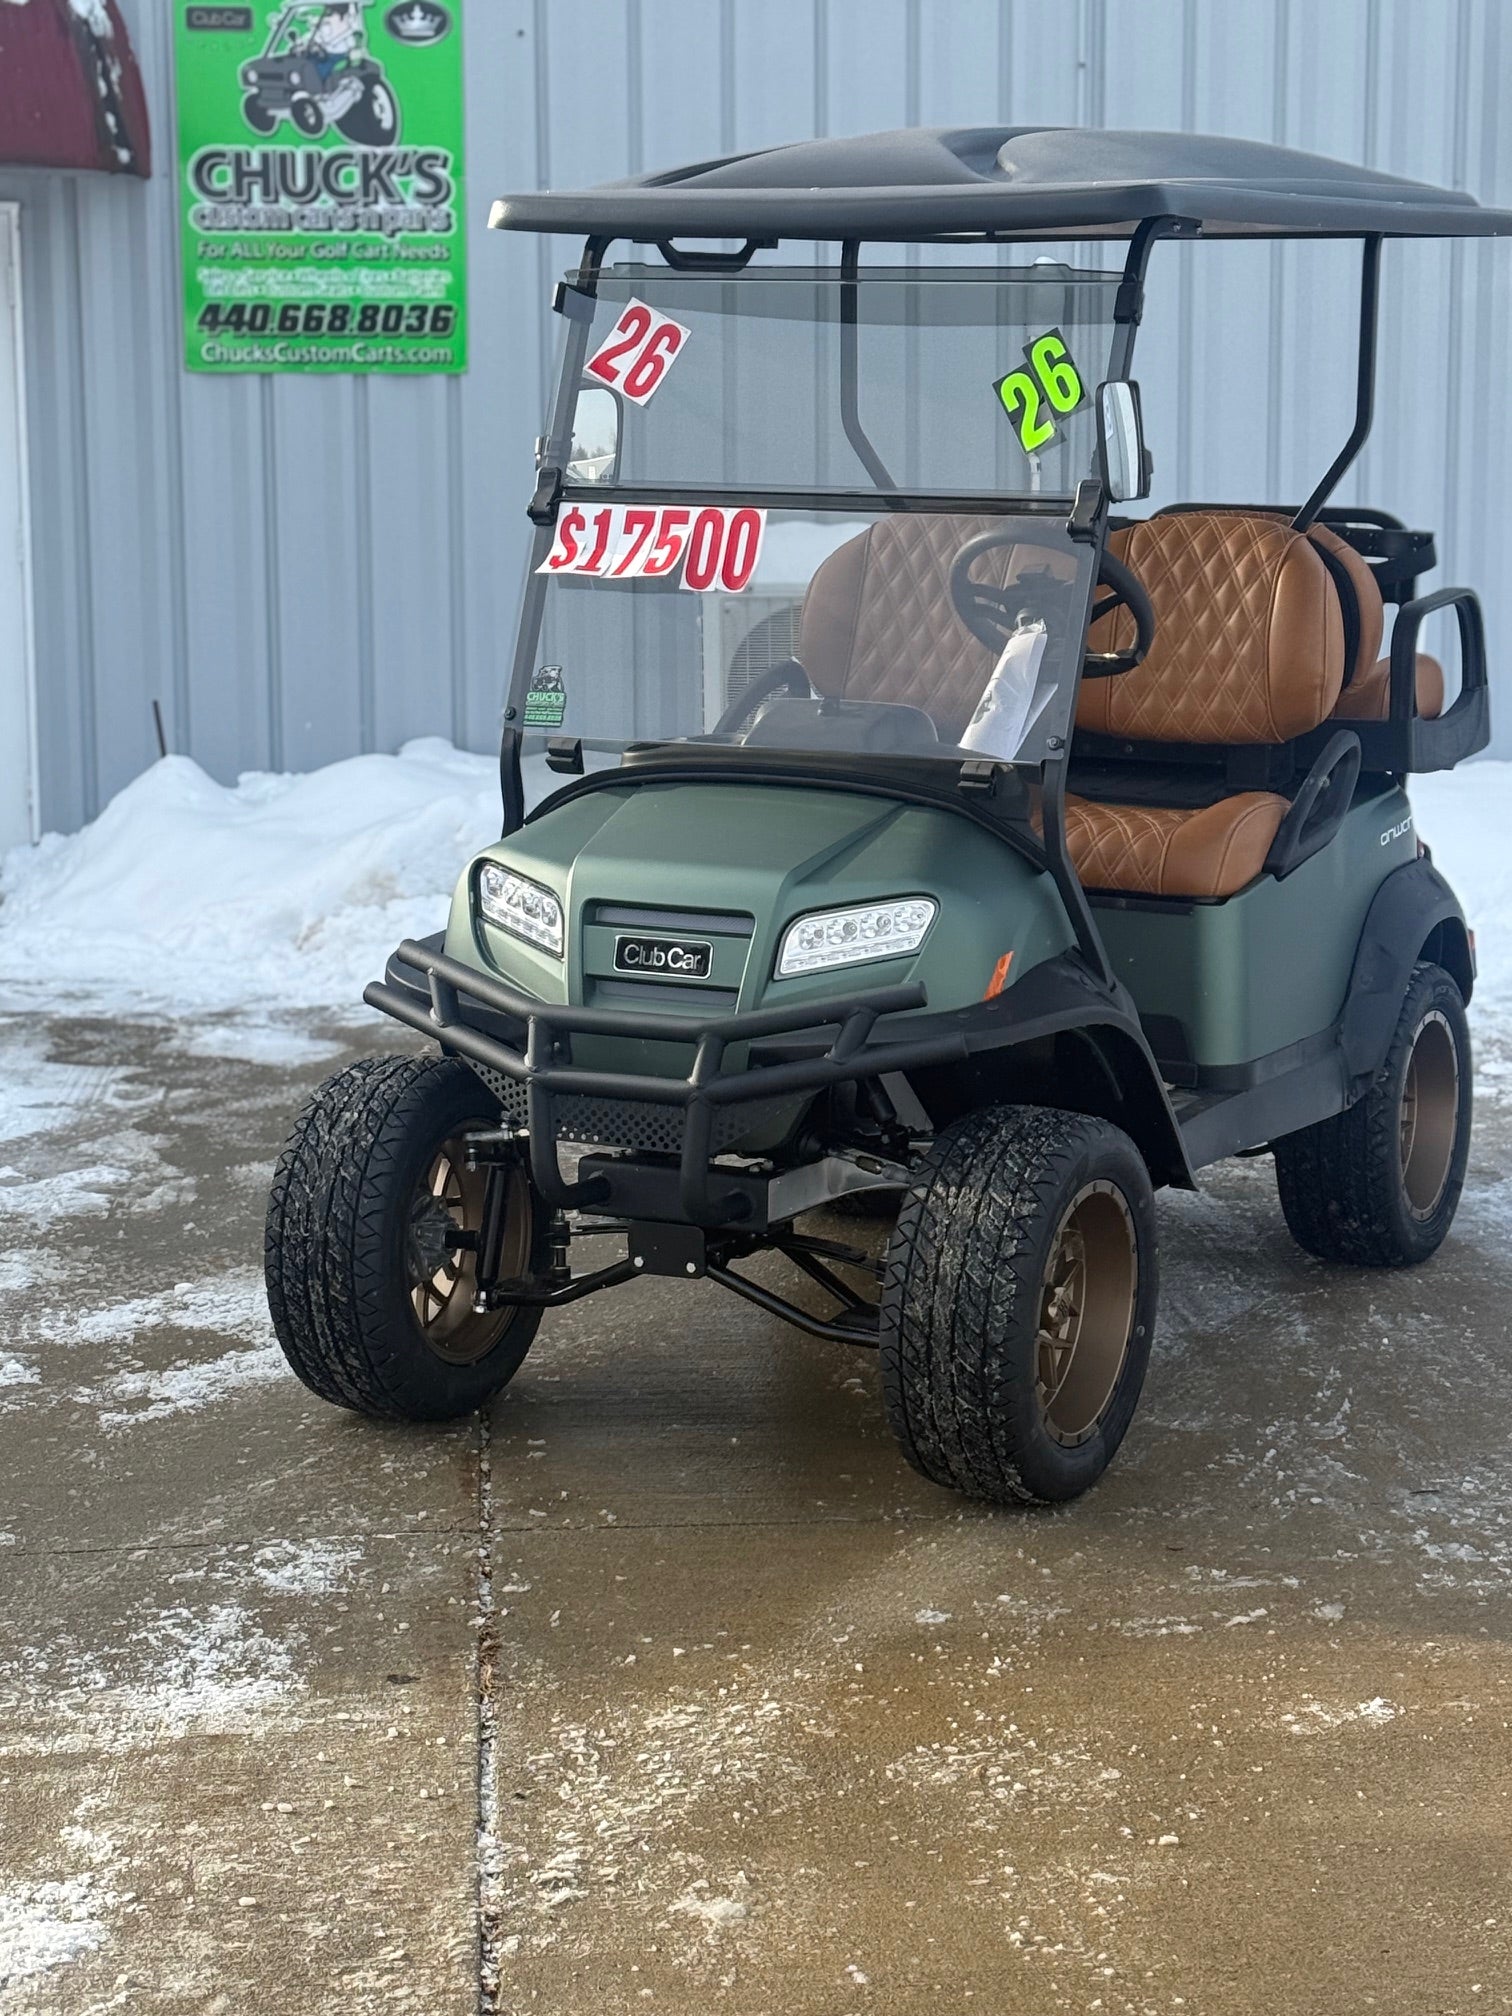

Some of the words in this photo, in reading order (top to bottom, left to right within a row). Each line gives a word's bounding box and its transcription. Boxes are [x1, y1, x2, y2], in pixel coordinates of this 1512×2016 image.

[193, 150, 452, 205] CHUCK'S
[193, 204, 293, 230] custom
[198, 242, 228, 258] For
[230, 242, 263, 258] ALL
[268, 242, 305, 259] Your
[310, 242, 347, 260] Golf
[351, 243, 392, 260] Cart
[392, 242, 449, 260] Needs
[197, 303, 456, 335] 440.668.8036
[201, 343, 453, 364] ChucksCustomCarts.com
[587, 306, 682, 398] 26
[1000, 336, 1081, 451] 26
[548, 507, 761, 590] $17500
[623, 944, 666, 967] Club
[667, 947, 701, 970] Car
